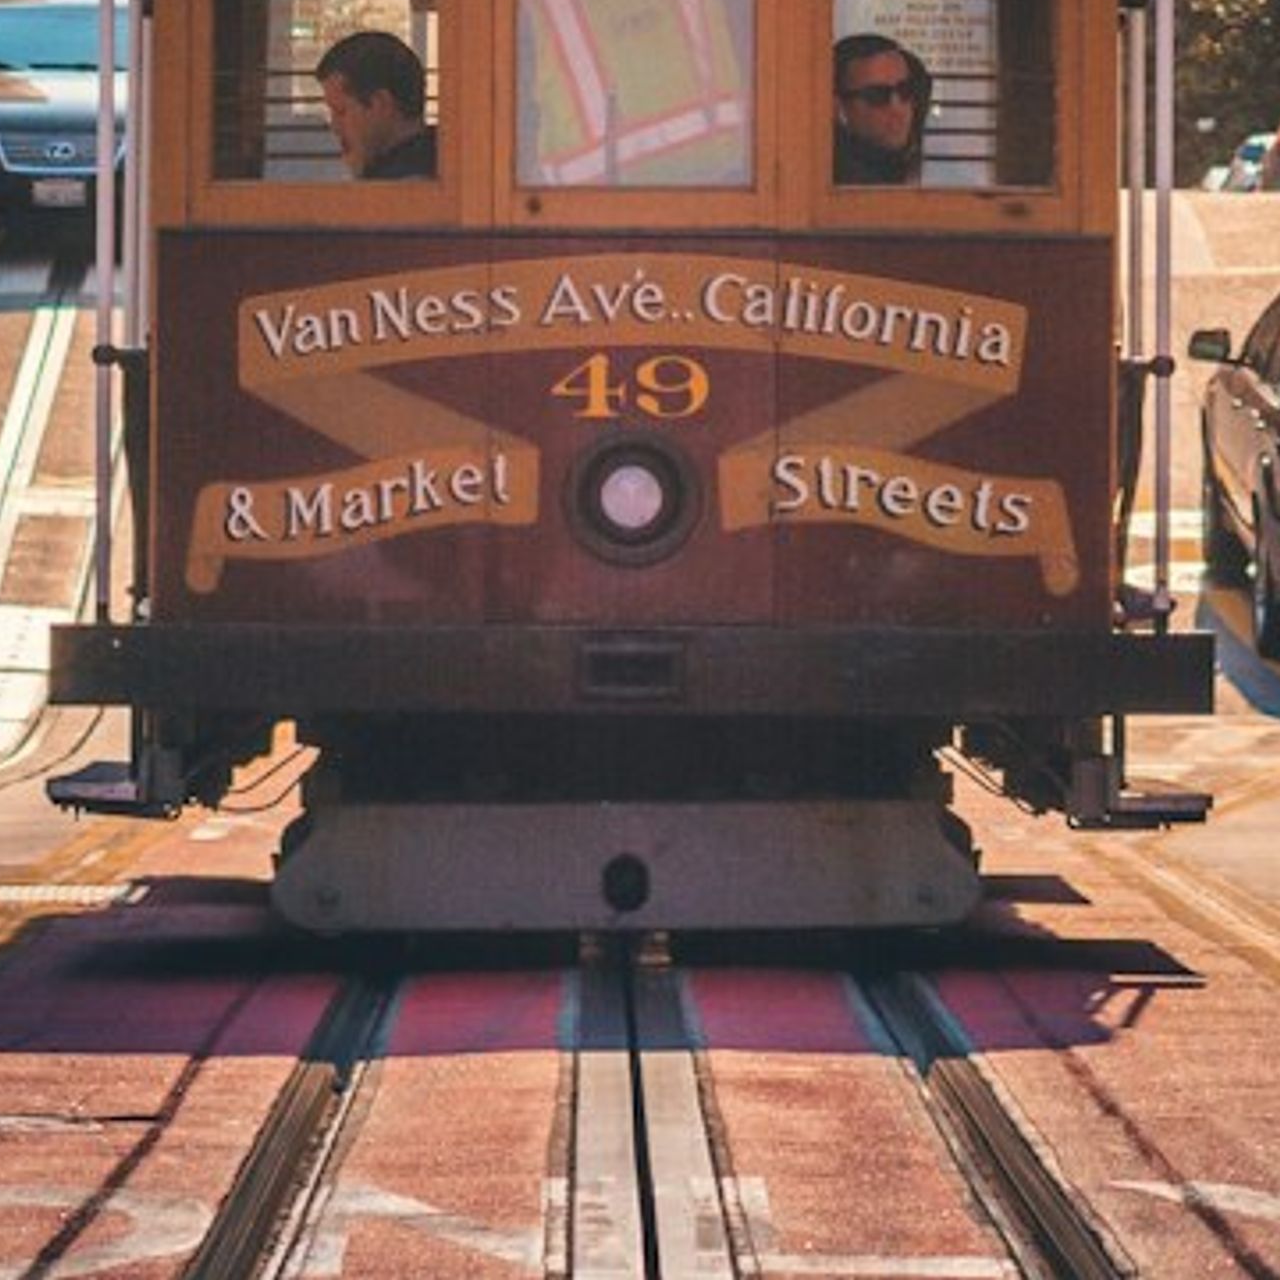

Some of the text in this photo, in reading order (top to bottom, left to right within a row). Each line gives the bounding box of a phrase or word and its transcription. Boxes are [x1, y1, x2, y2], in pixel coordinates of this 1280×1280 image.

[254, 303, 363, 360] Van
[366, 285, 521, 341] Ness
[701, 272, 1010, 366] California
[551, 353, 710, 419] 49
[225, 453, 1033, 541] & Market Streets
